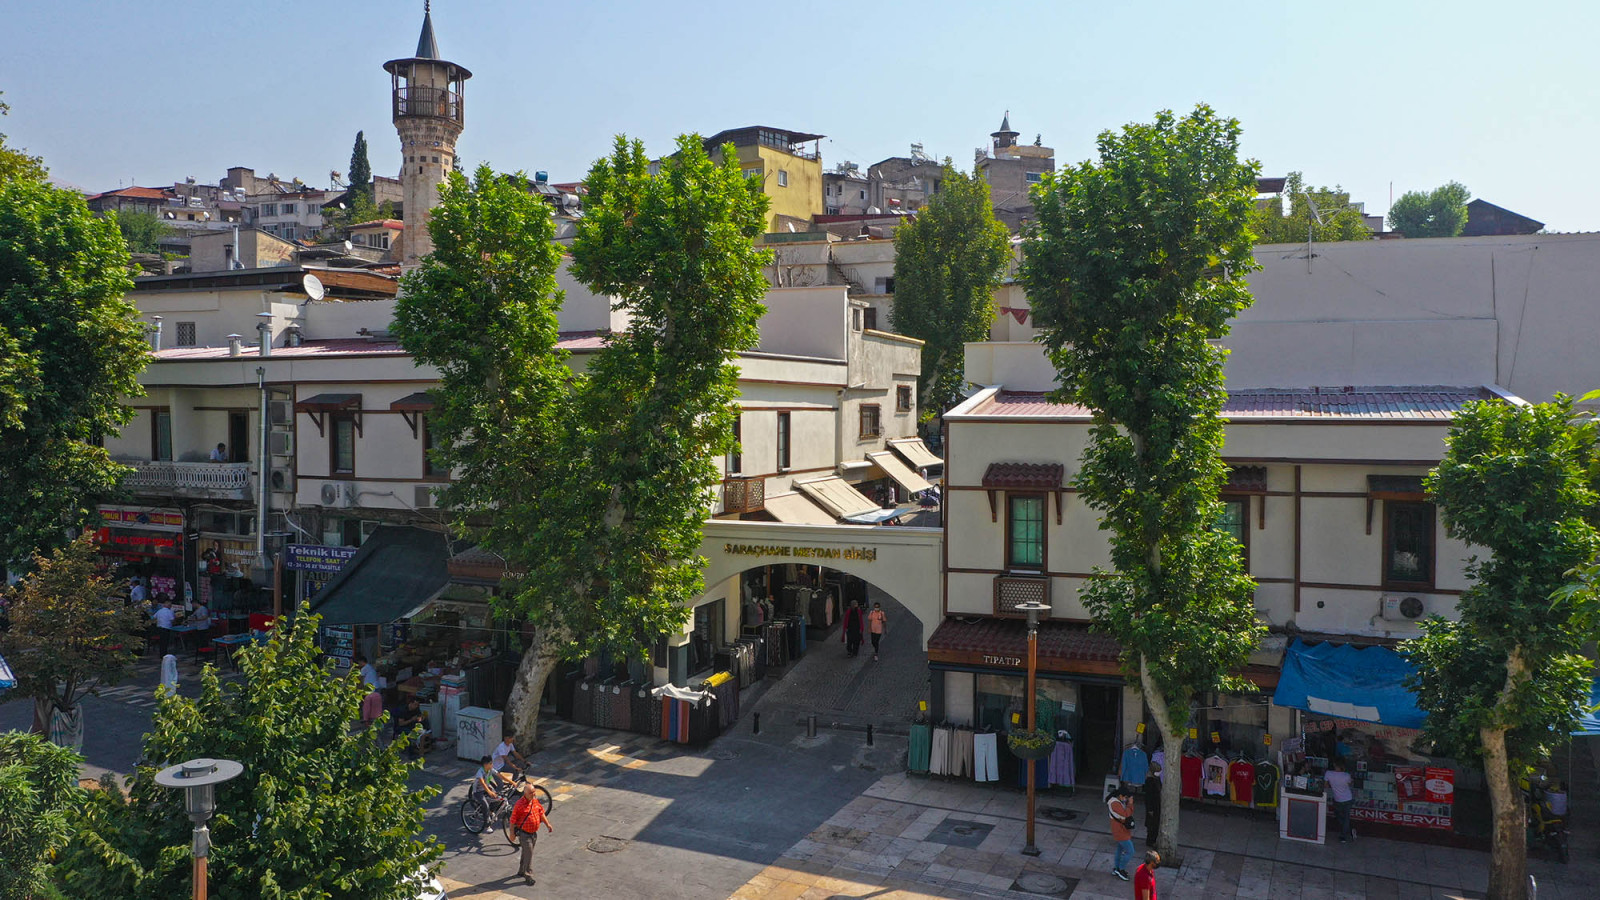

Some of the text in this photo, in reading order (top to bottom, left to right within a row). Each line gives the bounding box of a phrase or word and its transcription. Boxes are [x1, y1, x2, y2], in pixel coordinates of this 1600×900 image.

[287, 545, 328, 557] Teknik
[724, 543, 791, 558] SARAÇHANE
[793, 546, 841, 559] MEYDAN
[983, 655, 1021, 666] TIPATIP
[1349, 808, 1451, 826] EKNİK SERVİS
